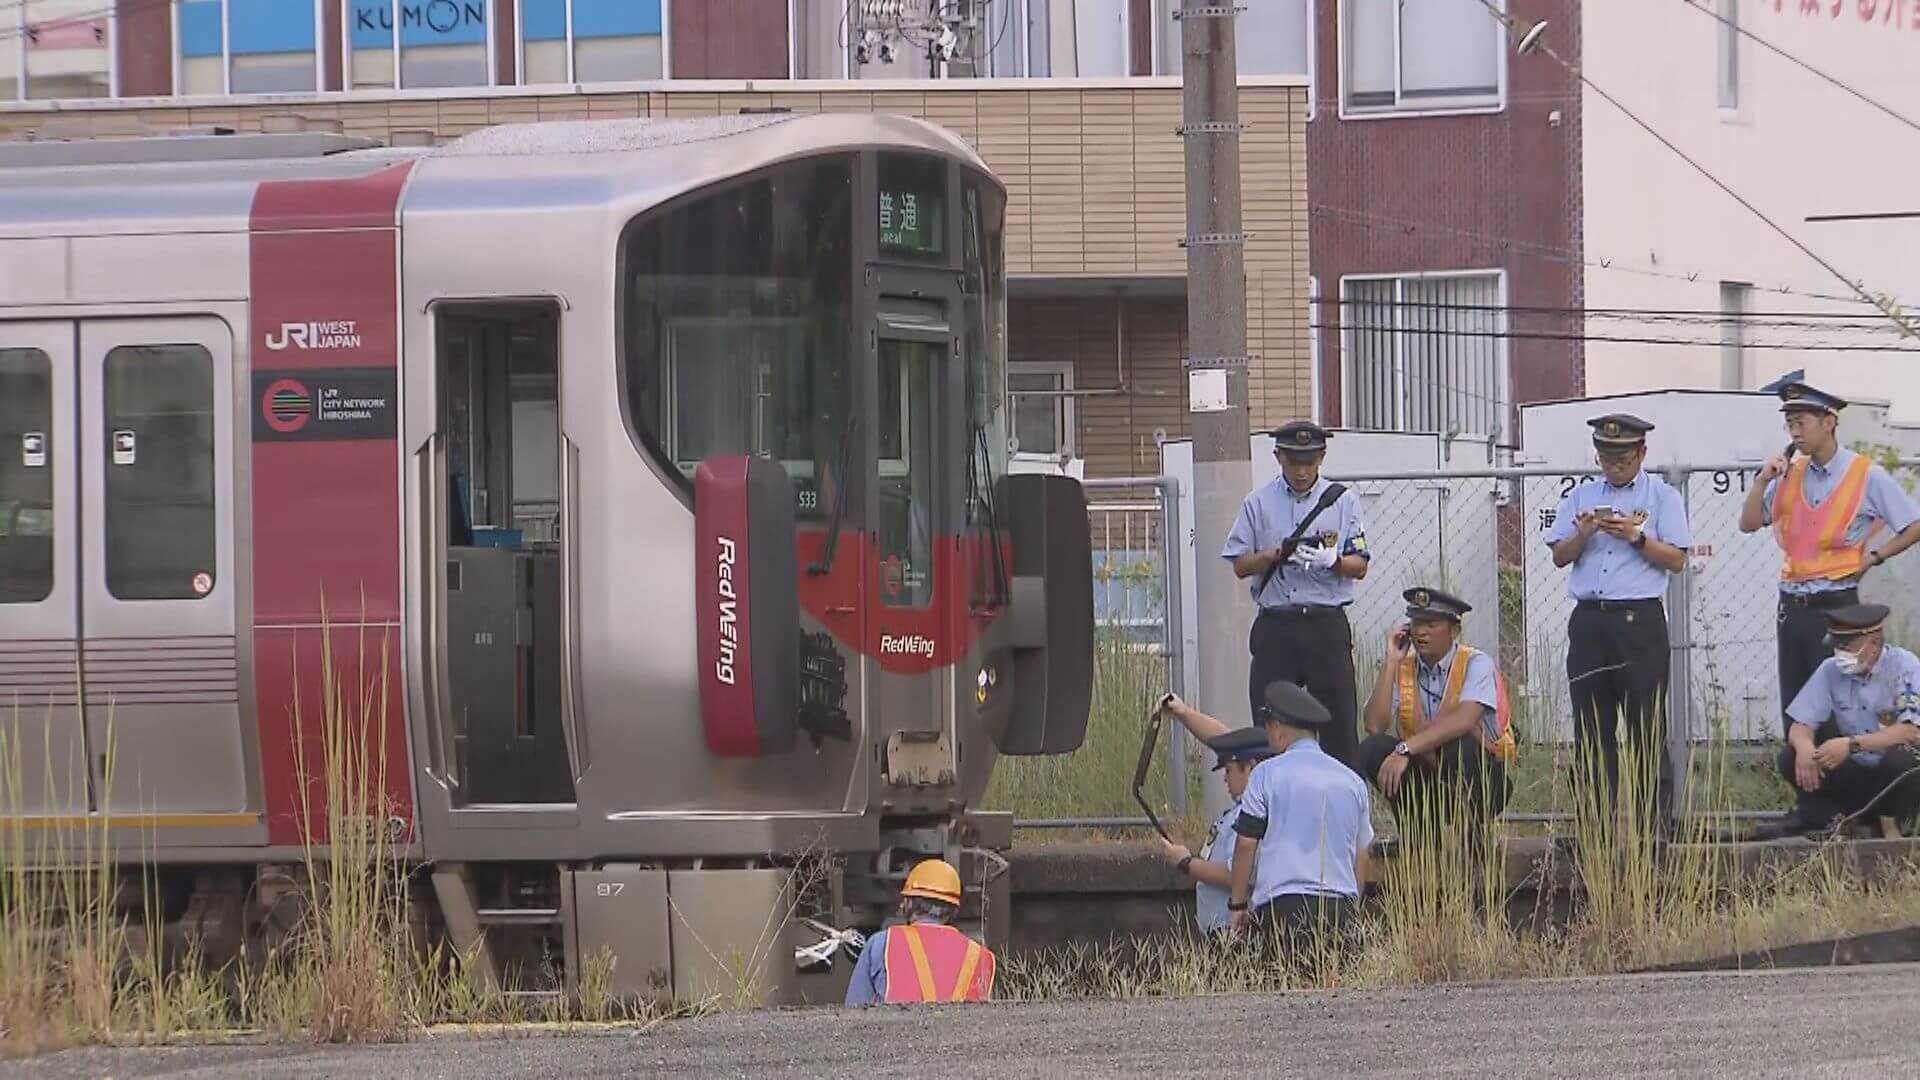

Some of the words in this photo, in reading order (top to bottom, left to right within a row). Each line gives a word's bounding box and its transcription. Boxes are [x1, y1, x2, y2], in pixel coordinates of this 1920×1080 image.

[357, 0, 483, 32] KUMON
[880, 192, 918, 230] 普通
[318, 321, 357, 335] WEST
[318, 335, 361, 349] JAPAN
[323, 388, 339, 398] JR
[323, 399, 342, 409] CITY
[343, 399, 385, 409] NETWORK
[323, 410, 372, 420] HIROSHIMA
[798, 490, 817, 508] S33
[716, 536, 738, 685] RedWing
[880, 635, 935, 658] RedWing
